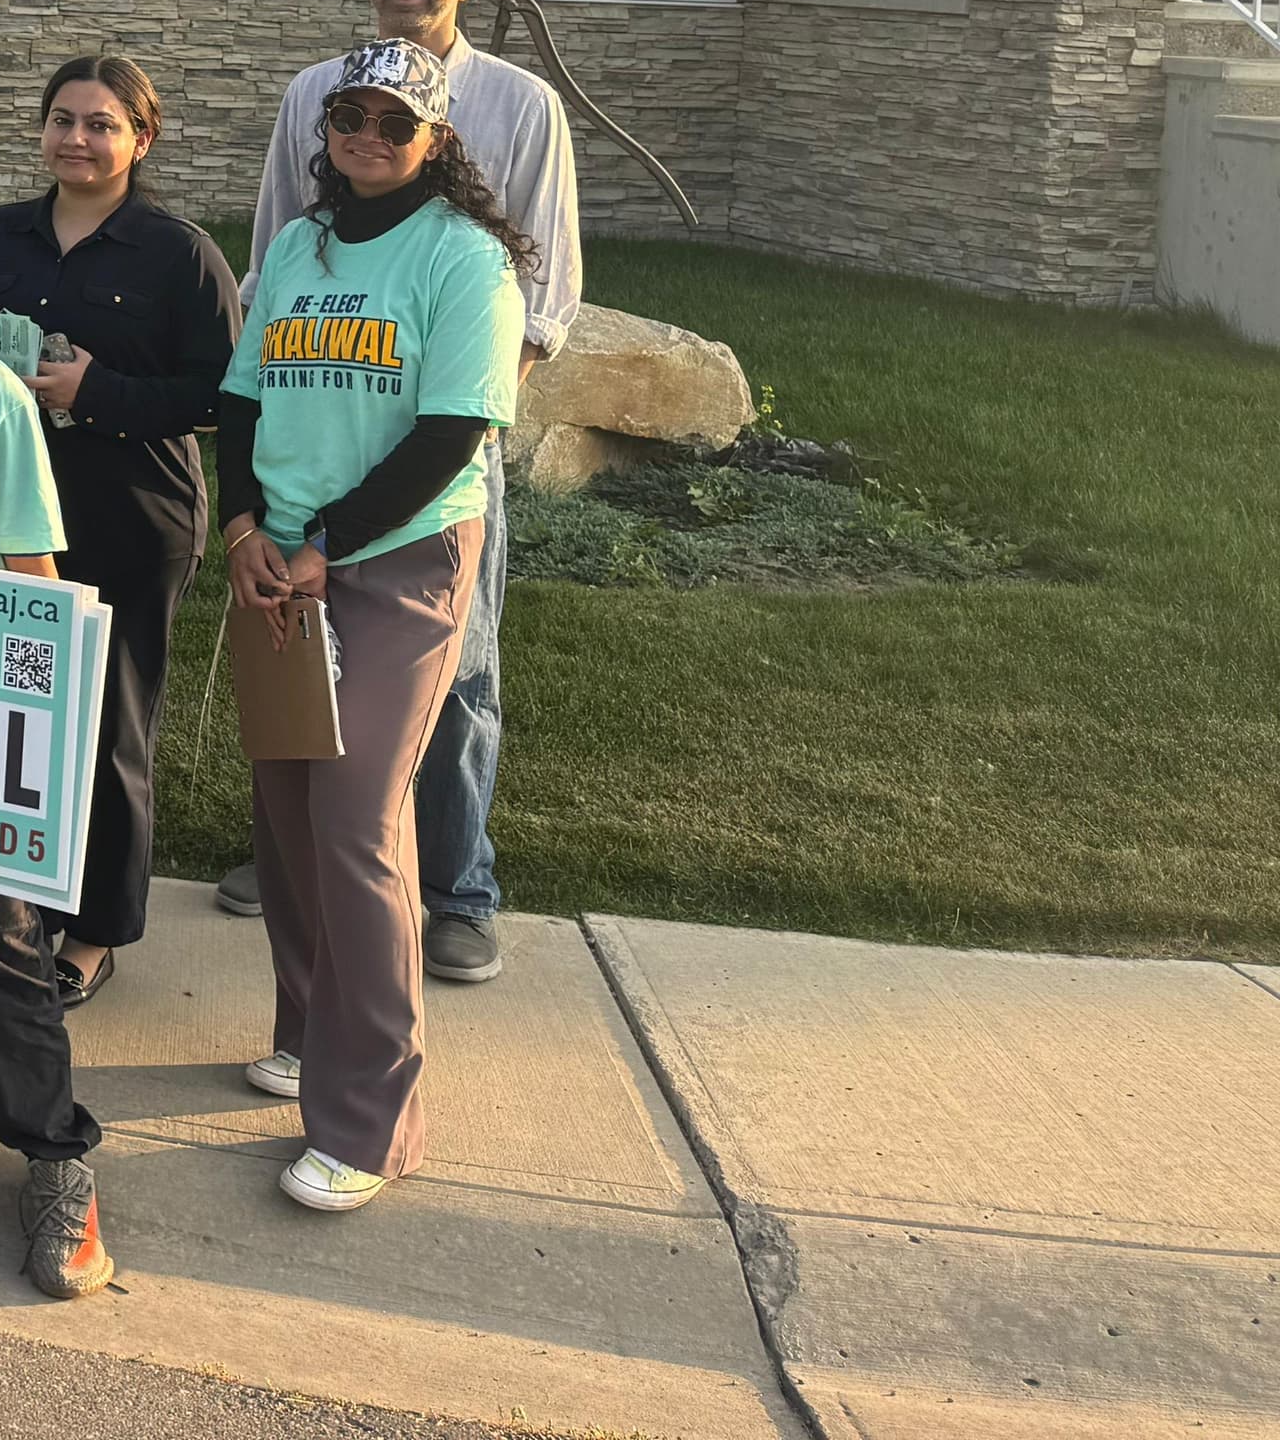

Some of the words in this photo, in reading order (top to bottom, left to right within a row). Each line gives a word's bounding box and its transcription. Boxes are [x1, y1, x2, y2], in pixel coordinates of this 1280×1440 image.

[290, 294, 368, 314] RE-ELECT
[259, 316, 404, 370] DHALIWAL
[259, 370, 314, 390] RKING
[322, 370, 353, 390] FOR
[365, 374, 402, 396] YOU
[27, 829, 46, 863] 5
